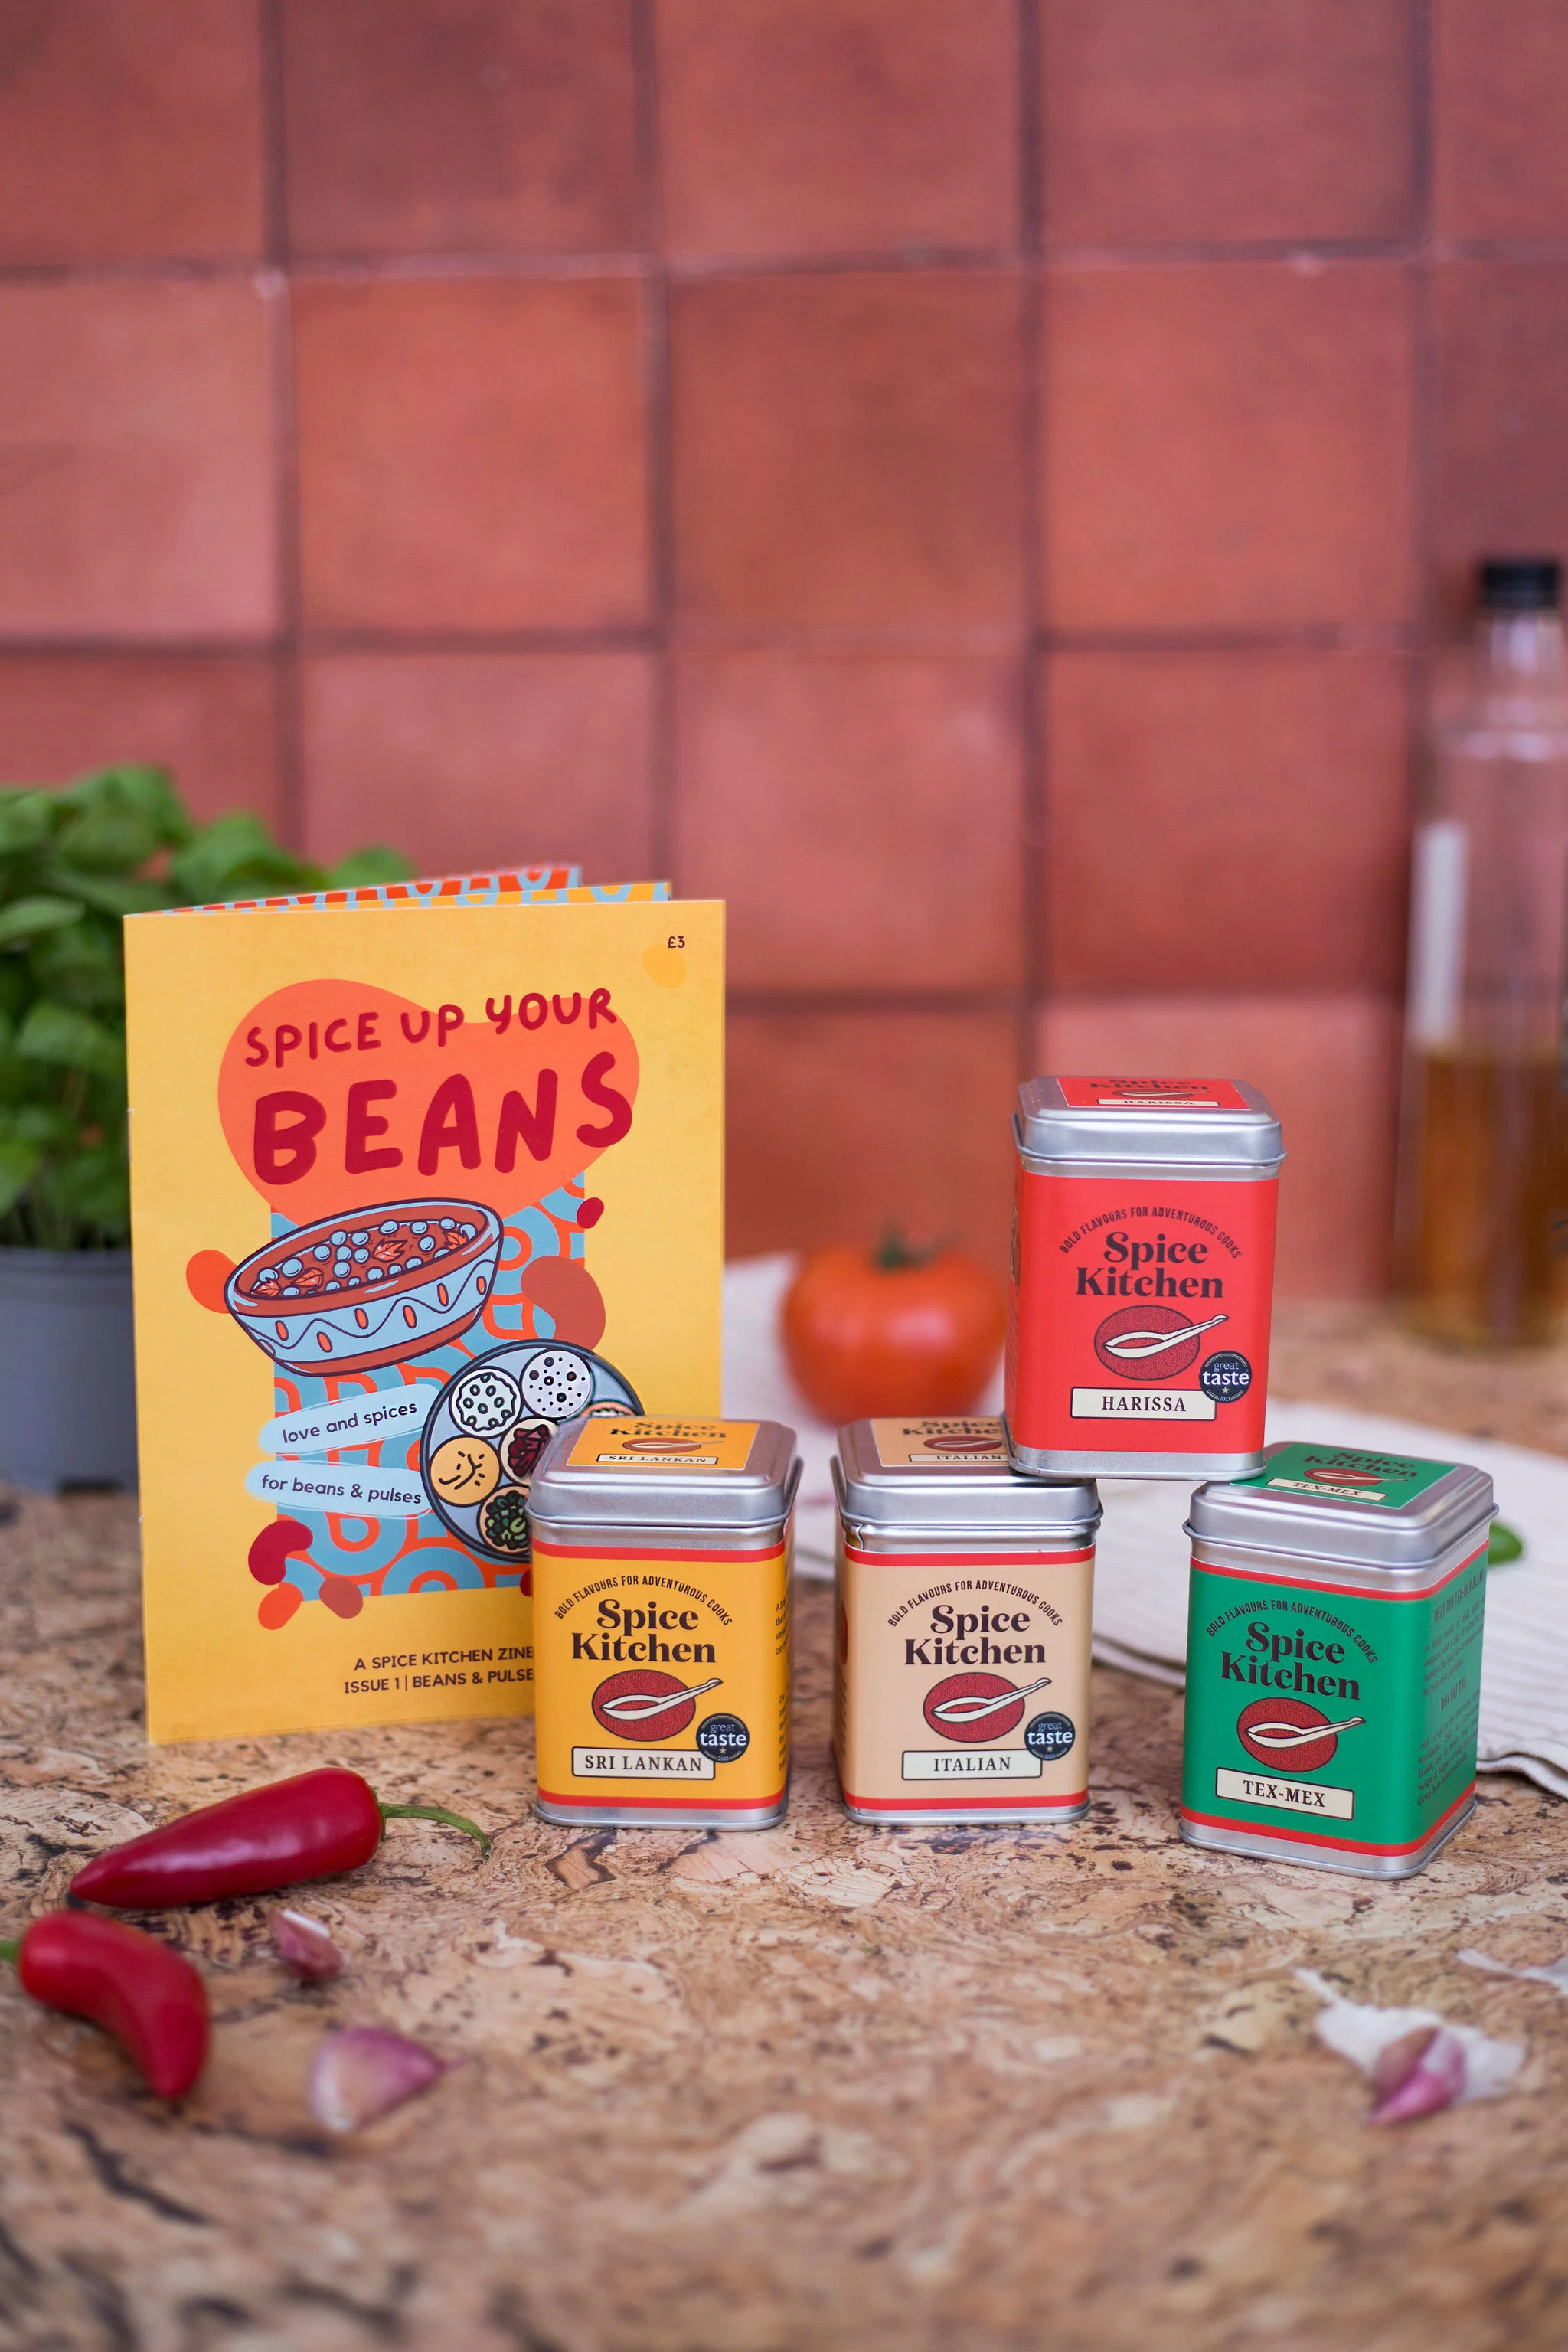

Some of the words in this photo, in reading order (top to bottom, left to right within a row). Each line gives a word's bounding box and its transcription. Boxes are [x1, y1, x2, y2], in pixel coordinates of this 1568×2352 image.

[668, 935, 686, 949] £3
[244, 1011, 381, 1068] SPICE
[400, 1003, 465, 1047] UP
[485, 988, 618, 1035] YOUR
[253, 1050, 633, 1185] BEANS
[1059, 1231, 1081, 1254] BOLD
[1080, 1209, 1128, 1235] FLAVOURS
[1130, 1207, 1148, 1217] FOR
[1152, 1207, 1218, 1235] ADVENTUROUS
[1217, 1231, 1242, 1259] COOKS
[1103, 1231, 1209, 1272] Spice
[1076, 1266, 1223, 1298] Kitchen
[1202, 1371, 1250, 1385] taste
[1213, 1361, 1240, 1373] great
[1102, 1396, 1187, 1413] HARISSA
[282, 1425, 321, 1444] love
[326, 1413, 359, 1433] and
[364, 1401, 418, 1426] spices
[610, 1428, 727, 1438] Kitchen
[902, 1427, 1001, 1436] Kitche
[1303, 1455, 1419, 1478] Kitchen
[1334, 1452, 1416, 1468] Spice
[262, 1473, 288, 1491] for
[292, 1477, 345, 1496] beans
[351, 1484, 364, 1498] &
[367, 1487, 422, 1505] pulses
[1293, 1481, 1362, 1496] TEX-MEX
[554, 1598, 575, 1619] BOLD
[573, 1577, 619, 1601] FLAVOURS
[621, 1575, 639, 1586] FOR
[642, 1575, 708, 1603] ADVENTUROUS
[707, 1599, 733, 1626] COOKS
[887, 1606, 908, 1627] BOLD
[907, 1583, 952, 1609] FLAVOURS
[955, 1580, 972, 1591] FOR
[975, 1579, 1040, 1606] ADVENTUROUS
[1038, 1600, 1063, 1626] COOKS
[596, 1599, 699, 1637] Spice
[930, 1605, 1031, 1640] Spice
[1206, 1617, 1227, 1637] BOLD
[1224, 1600, 1269, 1622] FLAVOURS
[1271, 1600, 1288, 1611] FOR
[1291, 1601, 1354, 1638] ADVENTUROUS
[1353, 1634, 1378, 1664] COOKS
[1245, 1622, 1345, 1664] Spice
[354, 1658, 366, 1671] A
[372, 1654, 417, 1669] SPICE
[422, 1648, 493, 1665] KITCHEN
[498, 1646, 534, 1660] ZINE
[572, 1632, 717, 1663] Kitchen
[904, 1637, 1046, 1665] Kitchen
[345, 1678, 389, 1694] ISSUE
[394, 1677, 400, 1689] 1
[413, 1672, 466, 1688] BEANS
[472, 1671, 483, 1684] &
[1220, 1651, 1361, 1700] Kitchen
[699, 1732, 747, 1746] taste
[710, 1723, 735, 1733] great
[1027, 1730, 1073, 1745] taste
[1037, 1721, 1063, 1732] great
[585, 1755, 616, 1770] SRI
[622, 1756, 702, 1772] LANKAN
[933, 1756, 1011, 1772] ITALIAN
[1243, 1779, 1325, 1808] TEX-MEX
